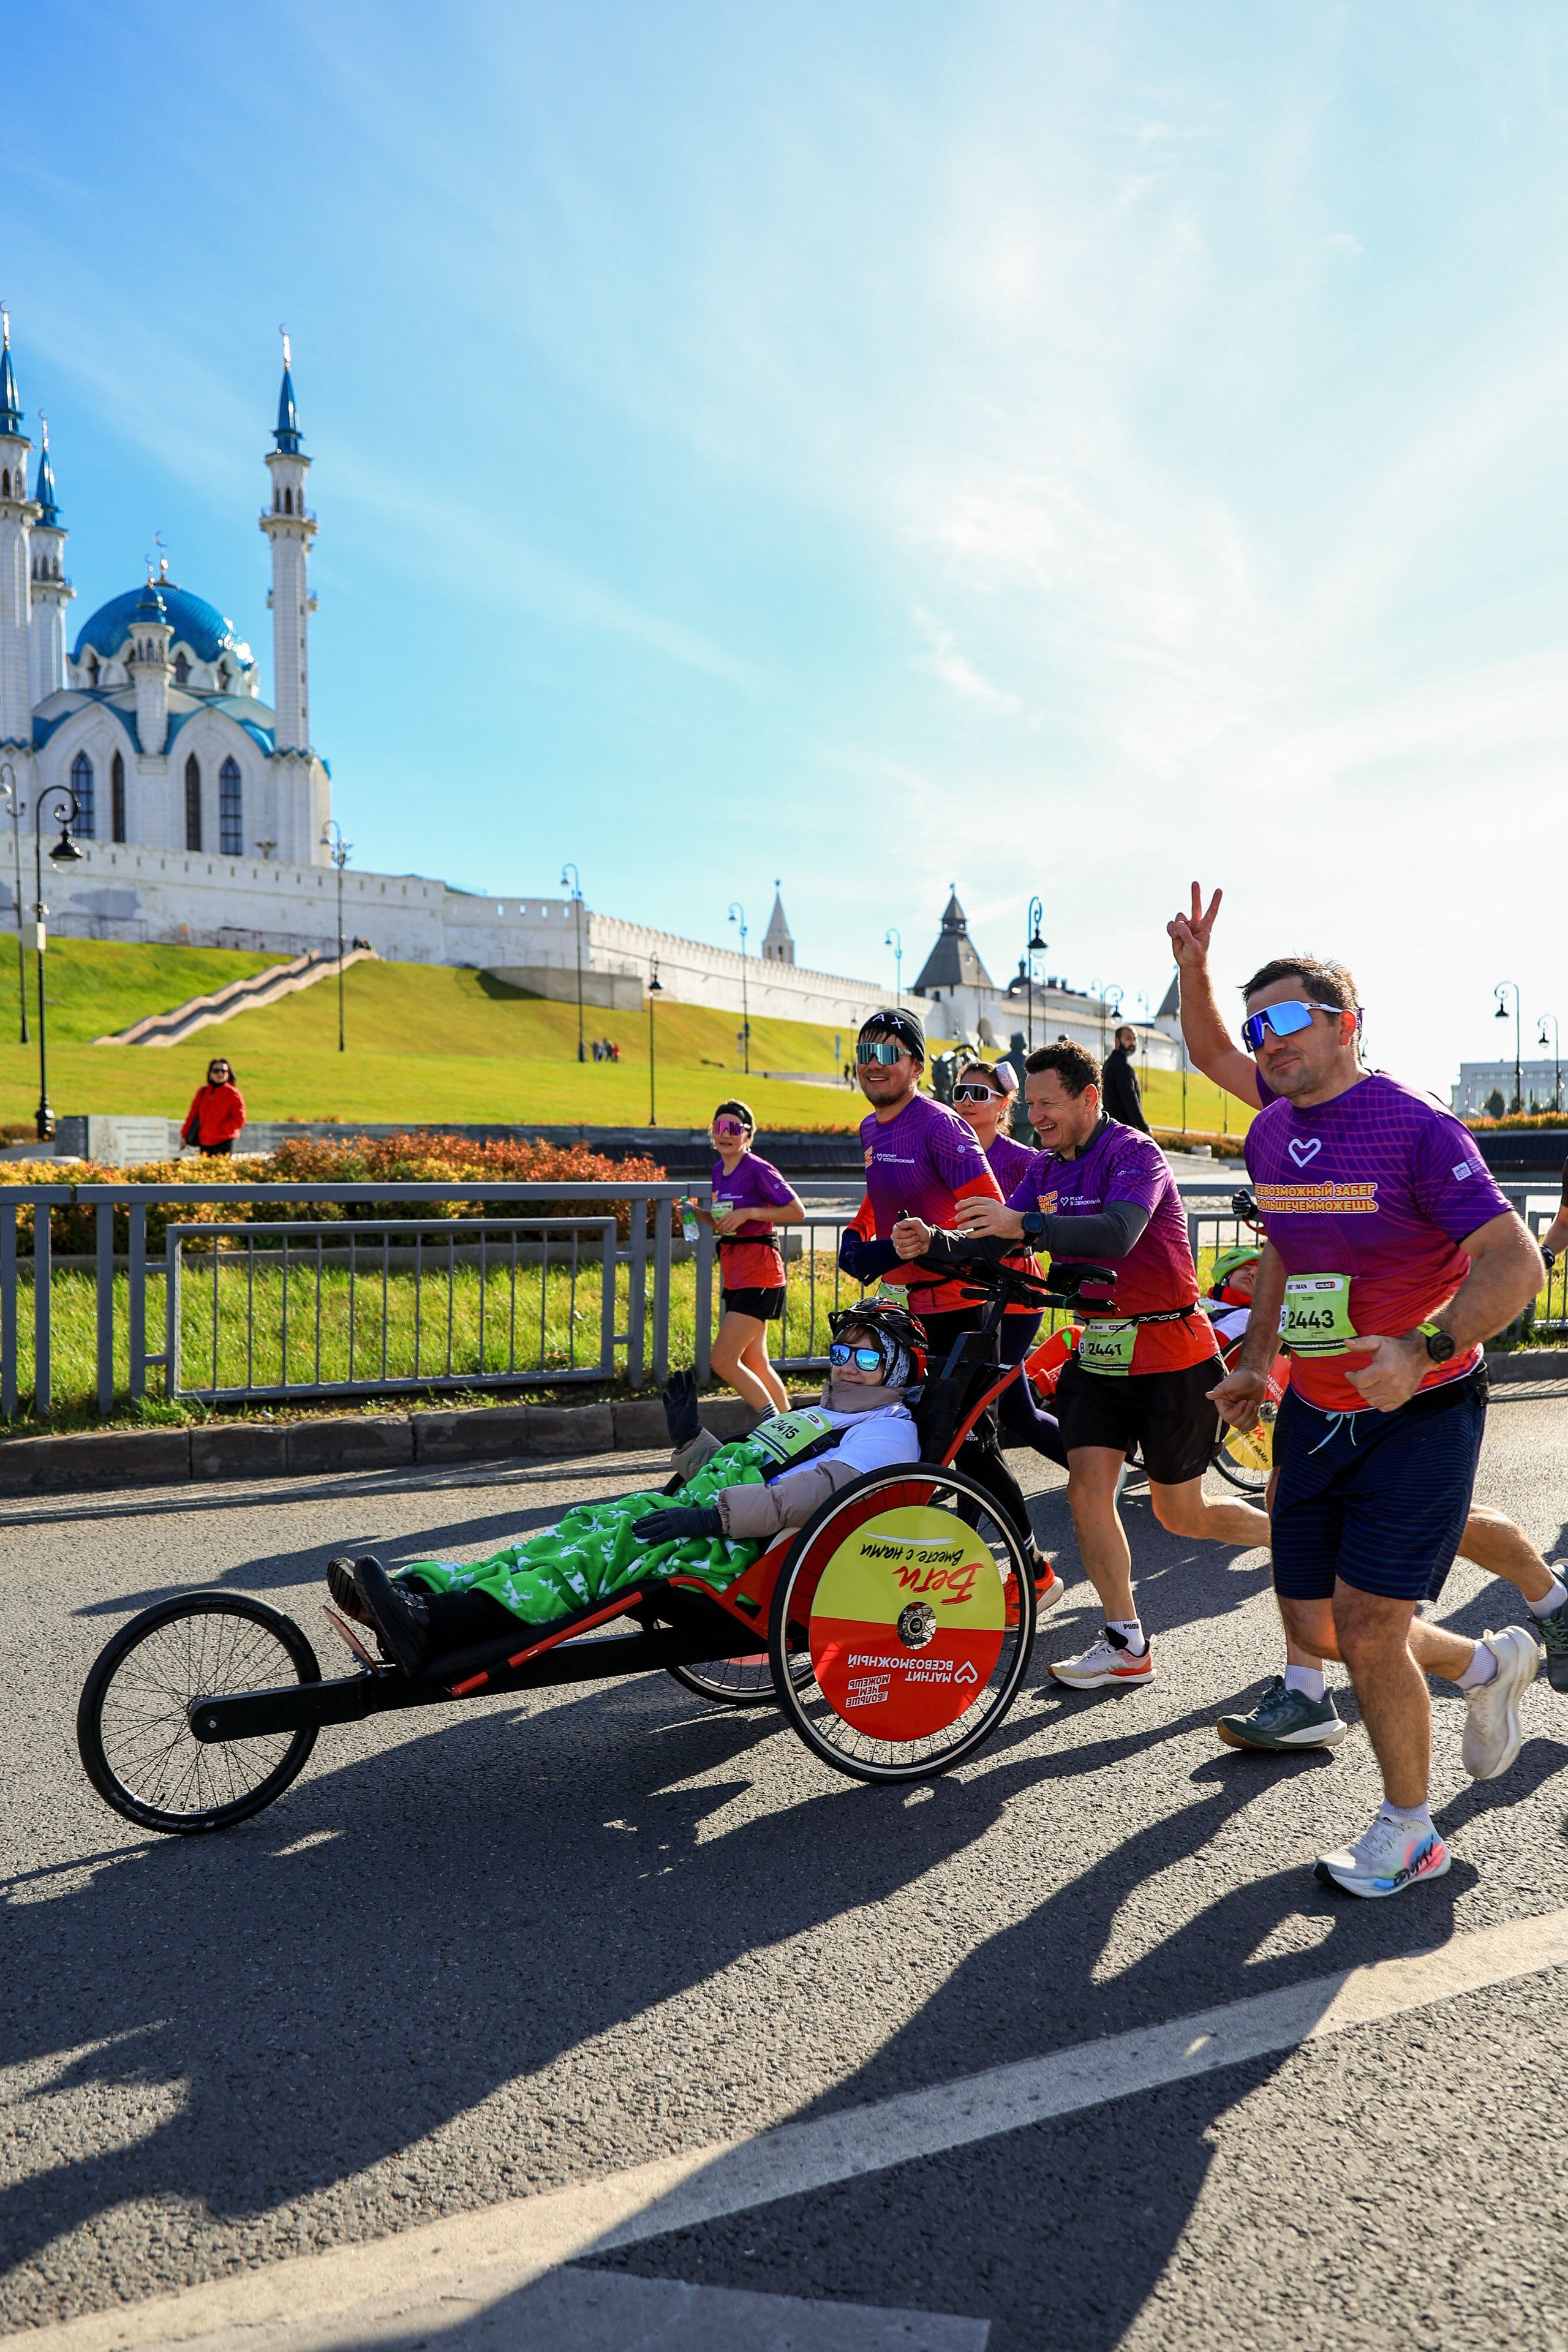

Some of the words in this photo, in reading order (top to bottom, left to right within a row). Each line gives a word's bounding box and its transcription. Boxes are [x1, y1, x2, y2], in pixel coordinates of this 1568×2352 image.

[1335, 1184, 1376, 1196] ЗАБЕГ
[1138, 1313, 1181, 1322] orca
[1288, 1310, 1335, 1329] 2443
[1080, 1342, 1085, 1354] B
[1088, 1343, 1122, 1356] 2441
[771, 1420, 800, 1439] 2415
[861, 1543, 903, 1560] нами
[906, 1549, 914, 1561] с
[891, 1562, 986, 1605] Беги
[848, 1654, 954, 1671] ВСЕВОЗМОЖНЫЙ
[848, 1674, 890, 1689] МОЖЕШЬ
[905, 1671, 952, 1683] МАГНИТ
[859, 1685, 878, 1696] ЧЕМ
[846, 1692, 888, 1708] БОЛЬШЕ
